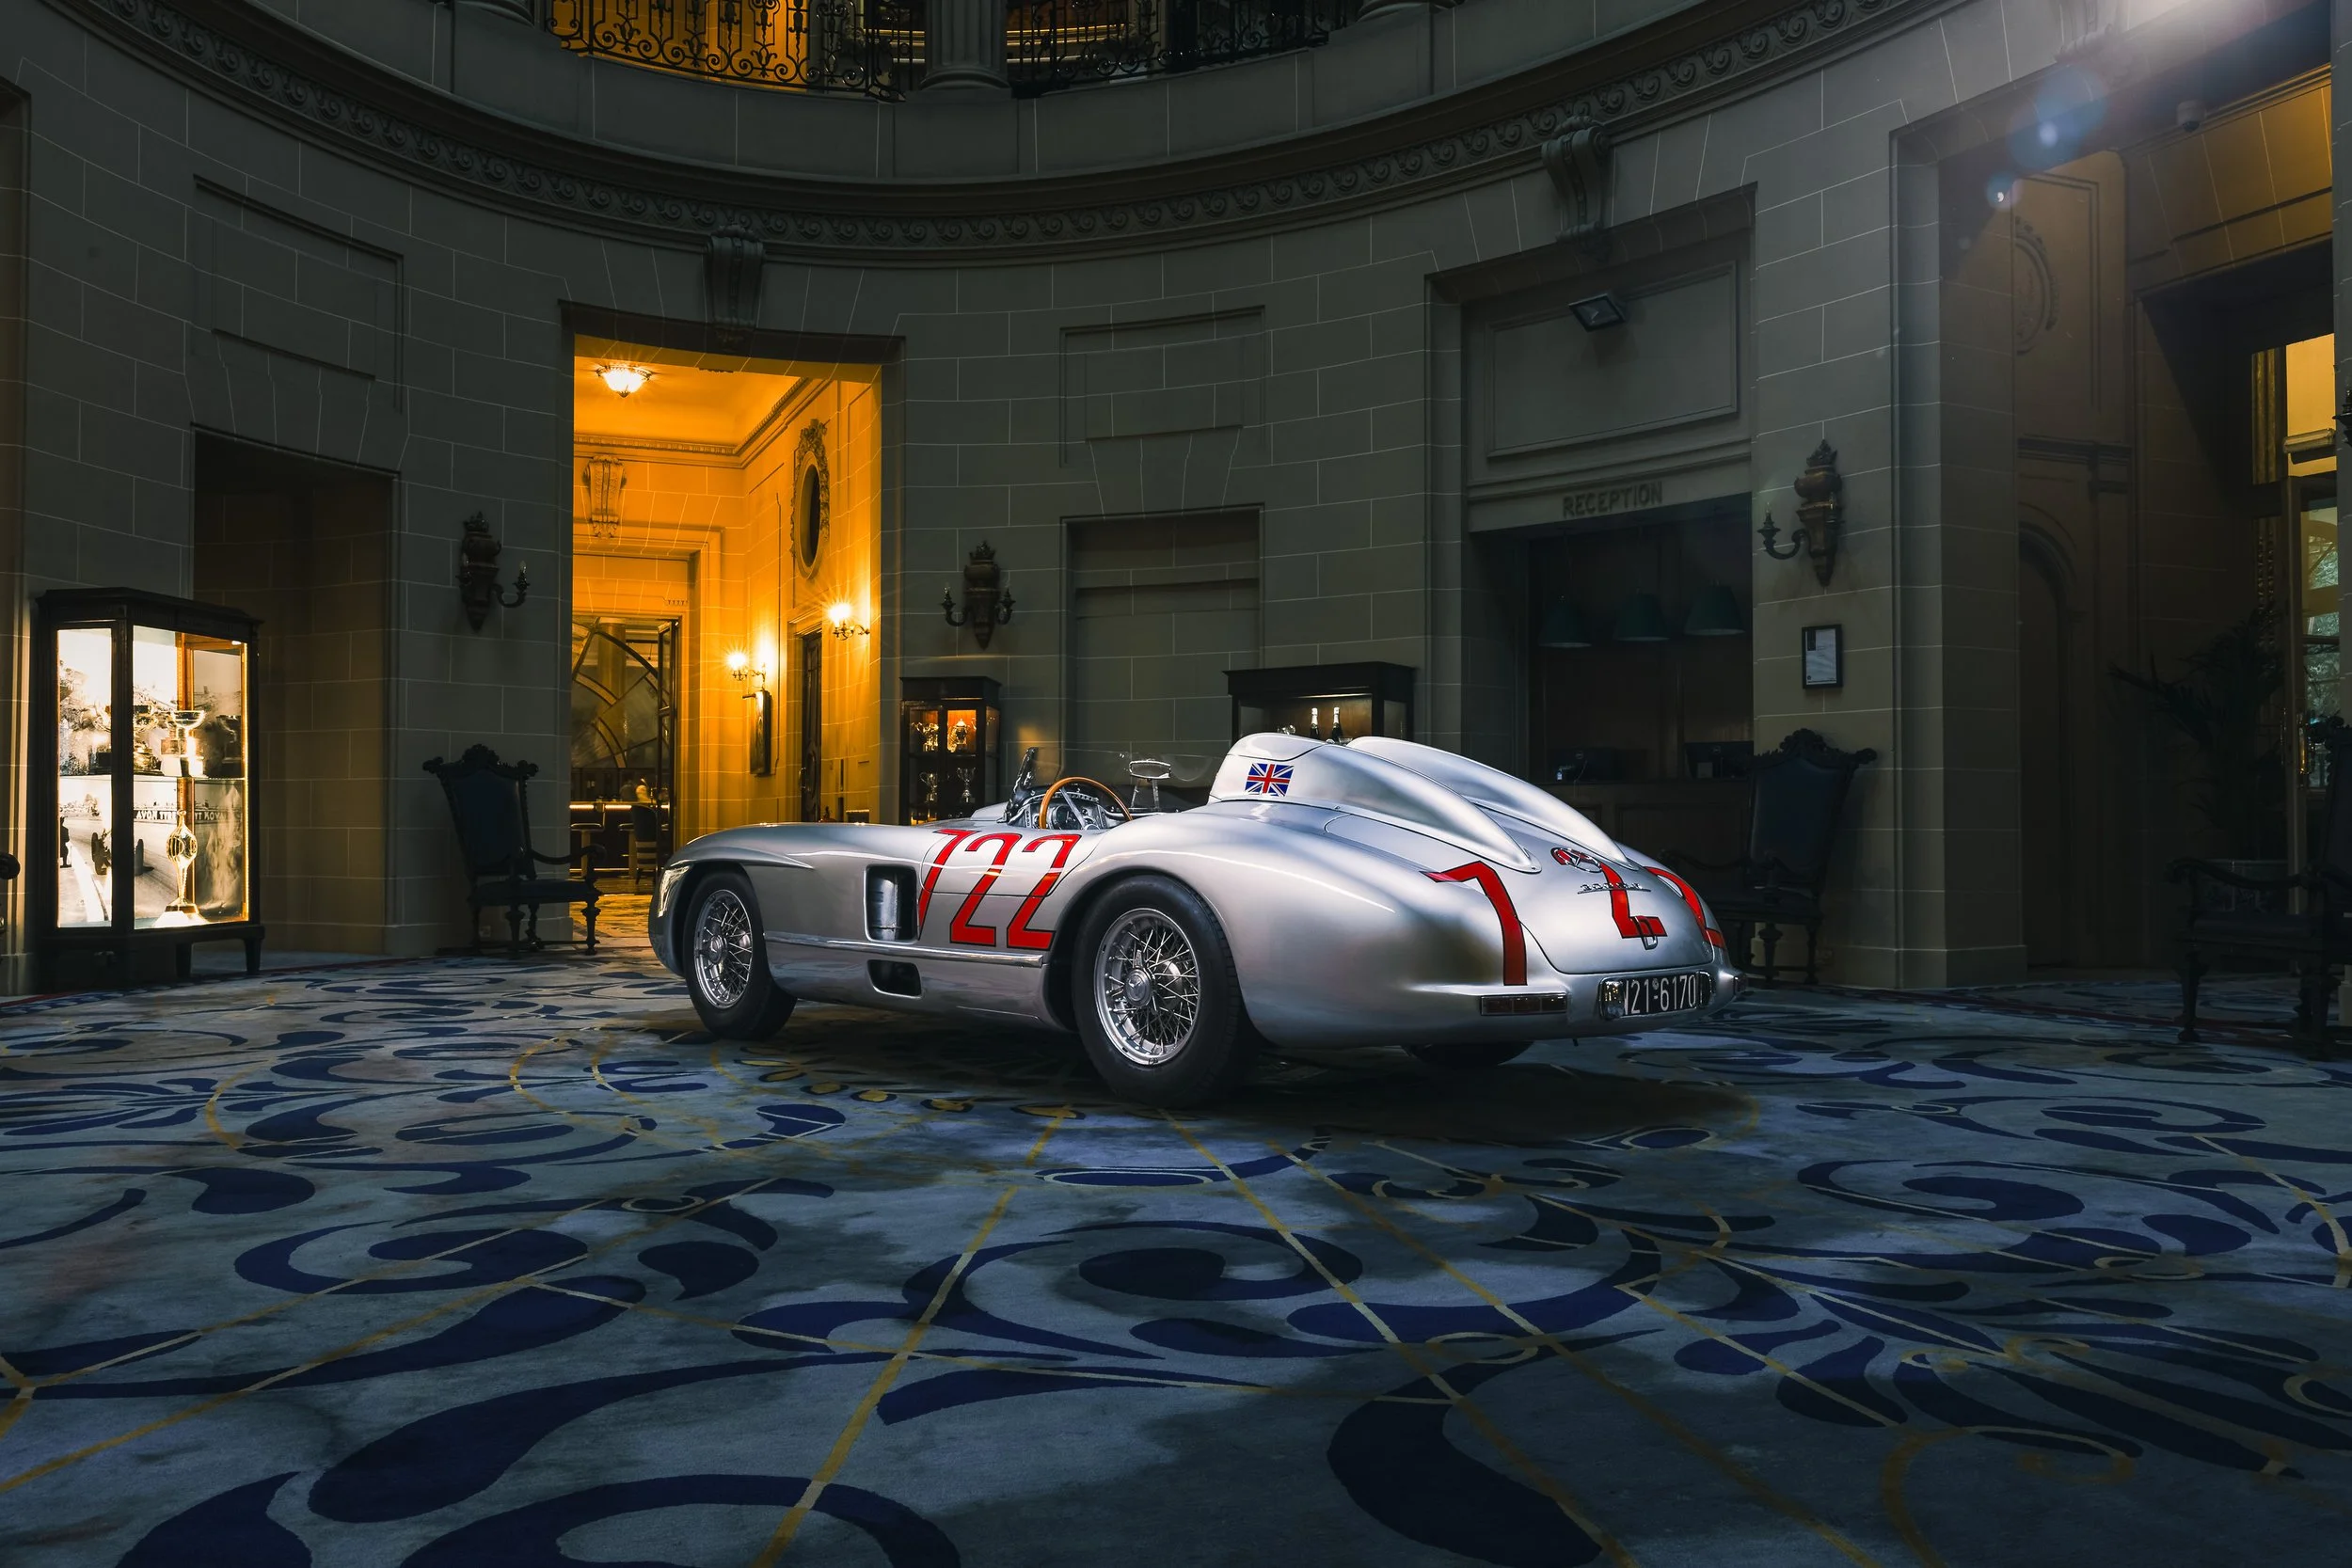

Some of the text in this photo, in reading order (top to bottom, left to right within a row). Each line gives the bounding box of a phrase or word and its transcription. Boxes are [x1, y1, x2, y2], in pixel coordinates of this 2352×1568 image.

[1562, 481, 1663, 519] RECEPTION
[136, 810, 158, 820] AVON
[917, 829, 1082, 951] 722
